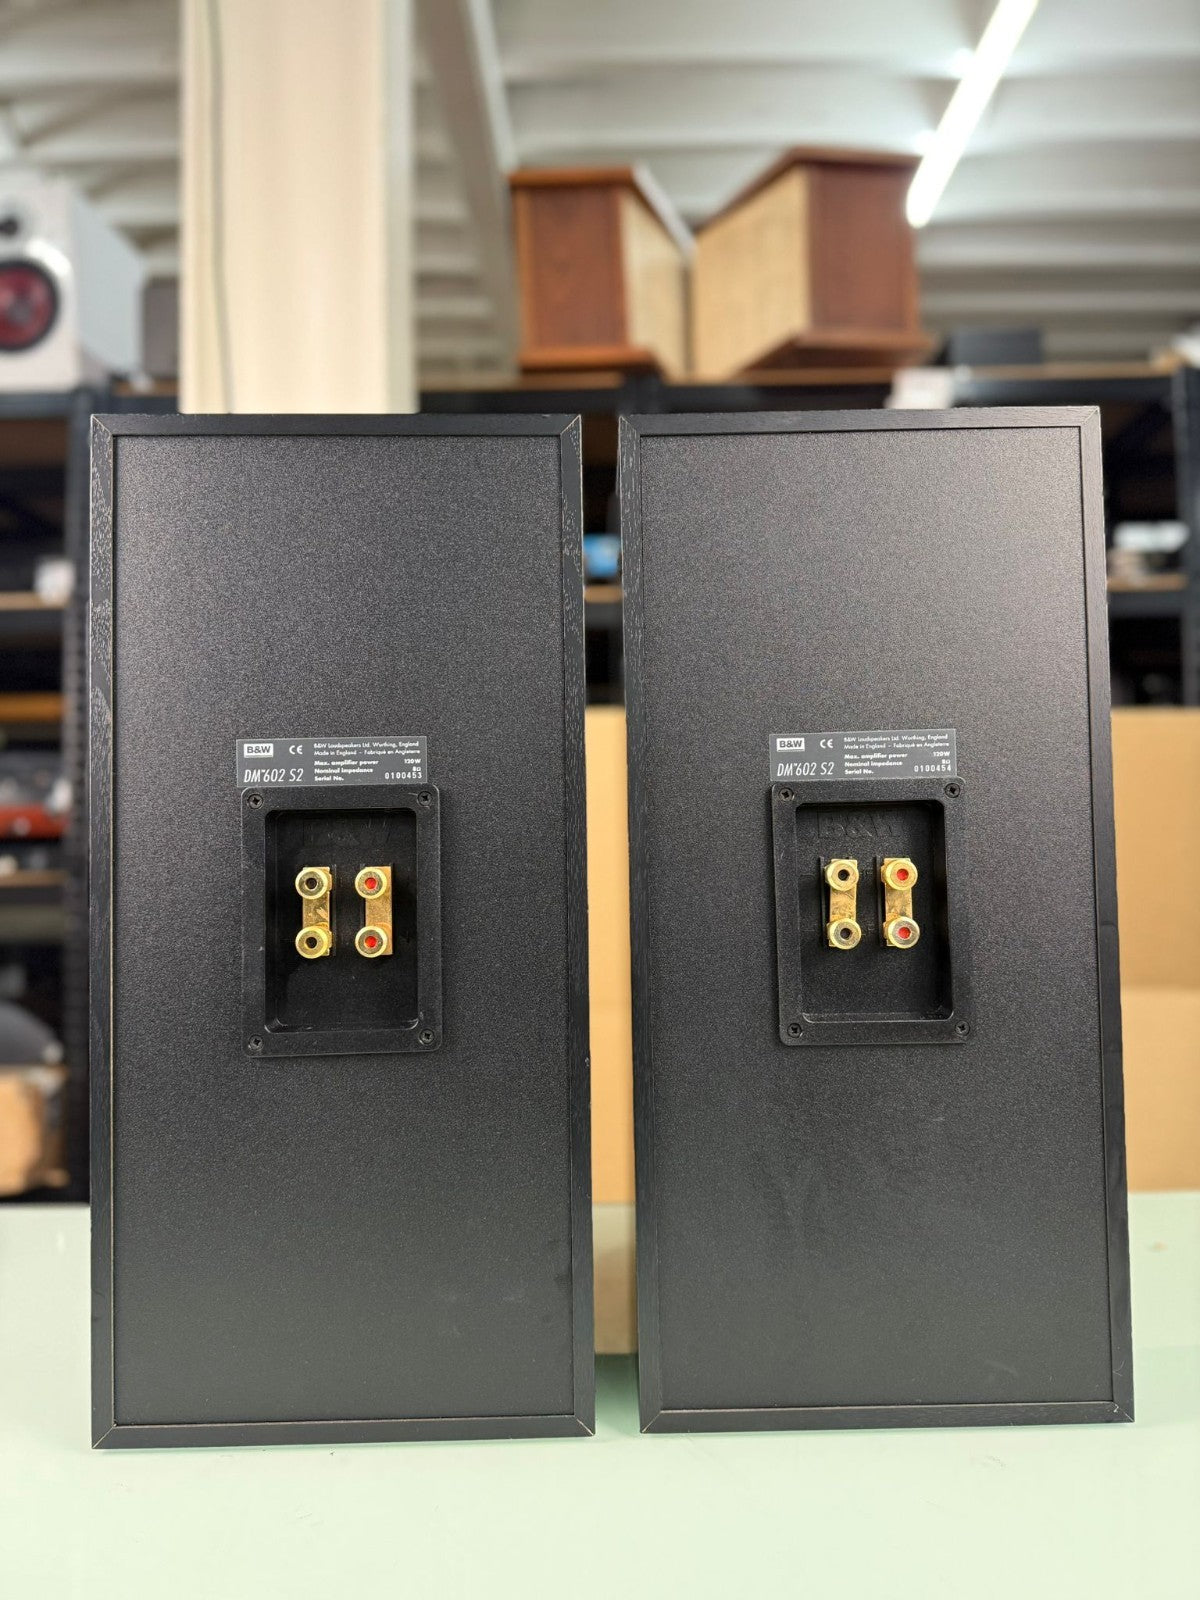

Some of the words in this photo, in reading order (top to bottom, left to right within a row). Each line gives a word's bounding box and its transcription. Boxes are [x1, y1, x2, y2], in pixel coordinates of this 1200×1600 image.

[820, 739, 833, 748] CE
[289, 745, 303, 754] CE
[820, 762, 834, 774] S2
[289, 768, 303, 782] S2
